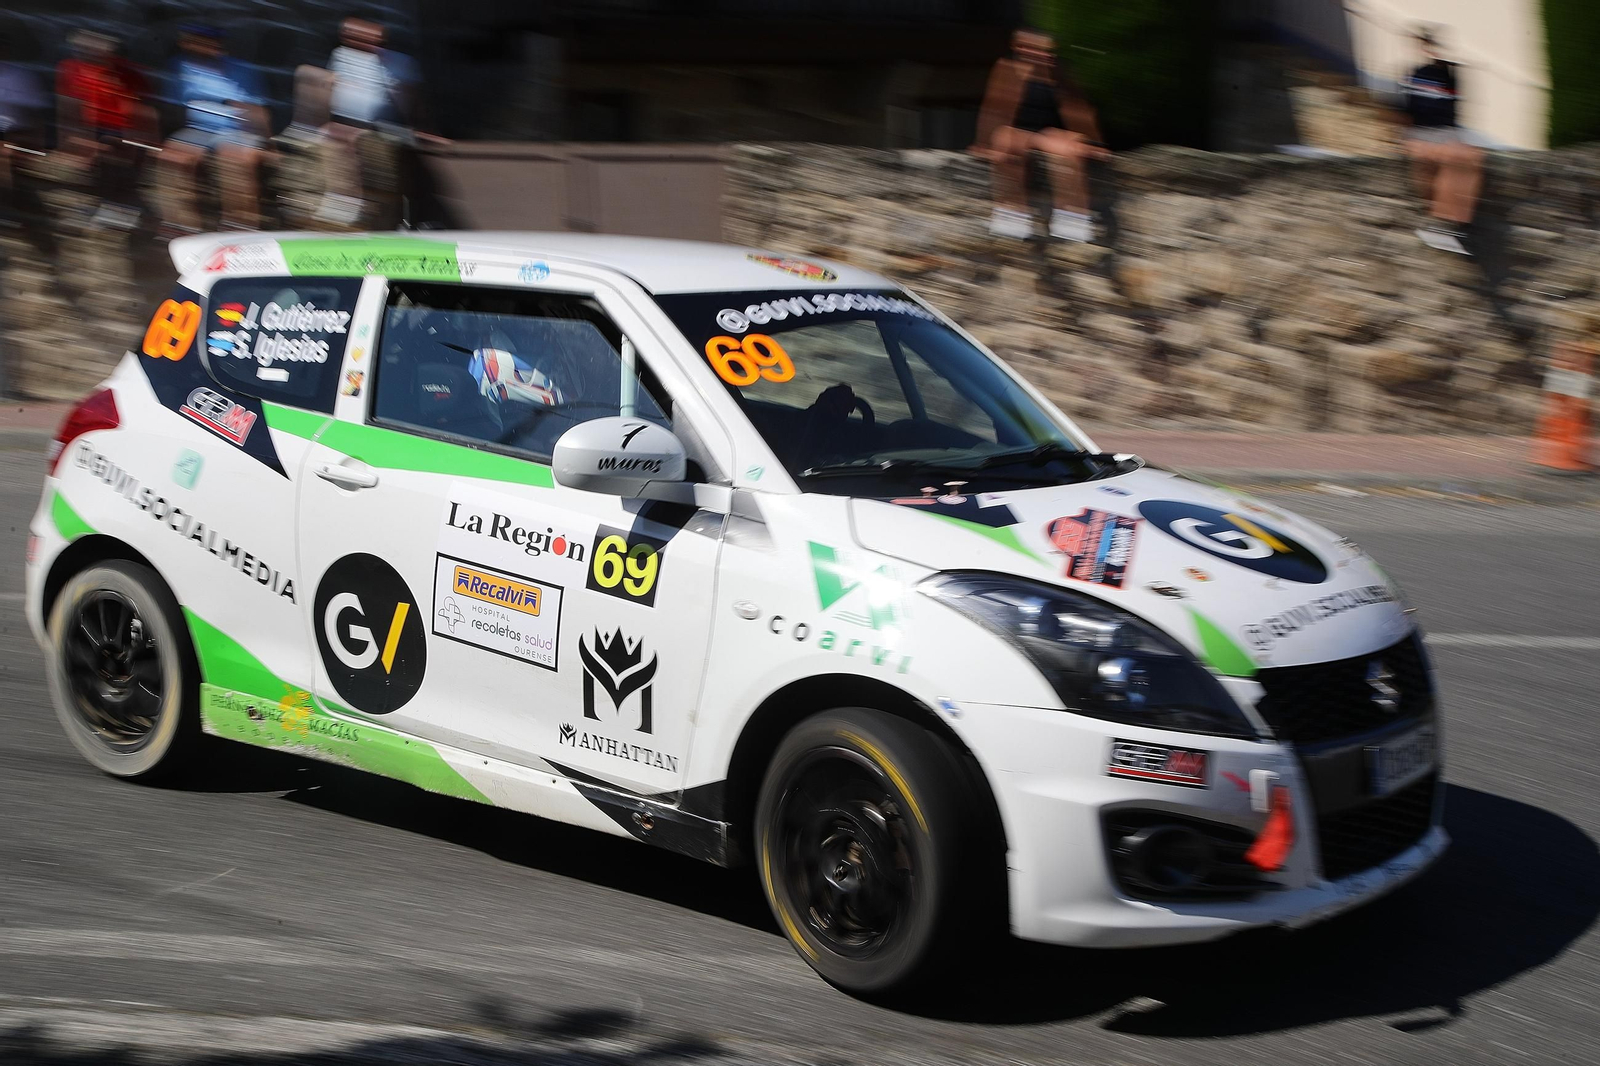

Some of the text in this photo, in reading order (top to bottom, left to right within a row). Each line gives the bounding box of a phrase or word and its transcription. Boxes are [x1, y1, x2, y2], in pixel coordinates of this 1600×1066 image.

[705, 333, 796, 386] 69
[446, 500, 483, 535] La
[593, 534, 659, 598] 69
[469, 575, 525, 606] Recalvi
[471, 604, 511, 623] HOSPITAL
[470, 616, 554, 652] recoletas salud
[514, 644, 553, 665] OURENSE
[558, 721, 681, 774] MANHATTAN
